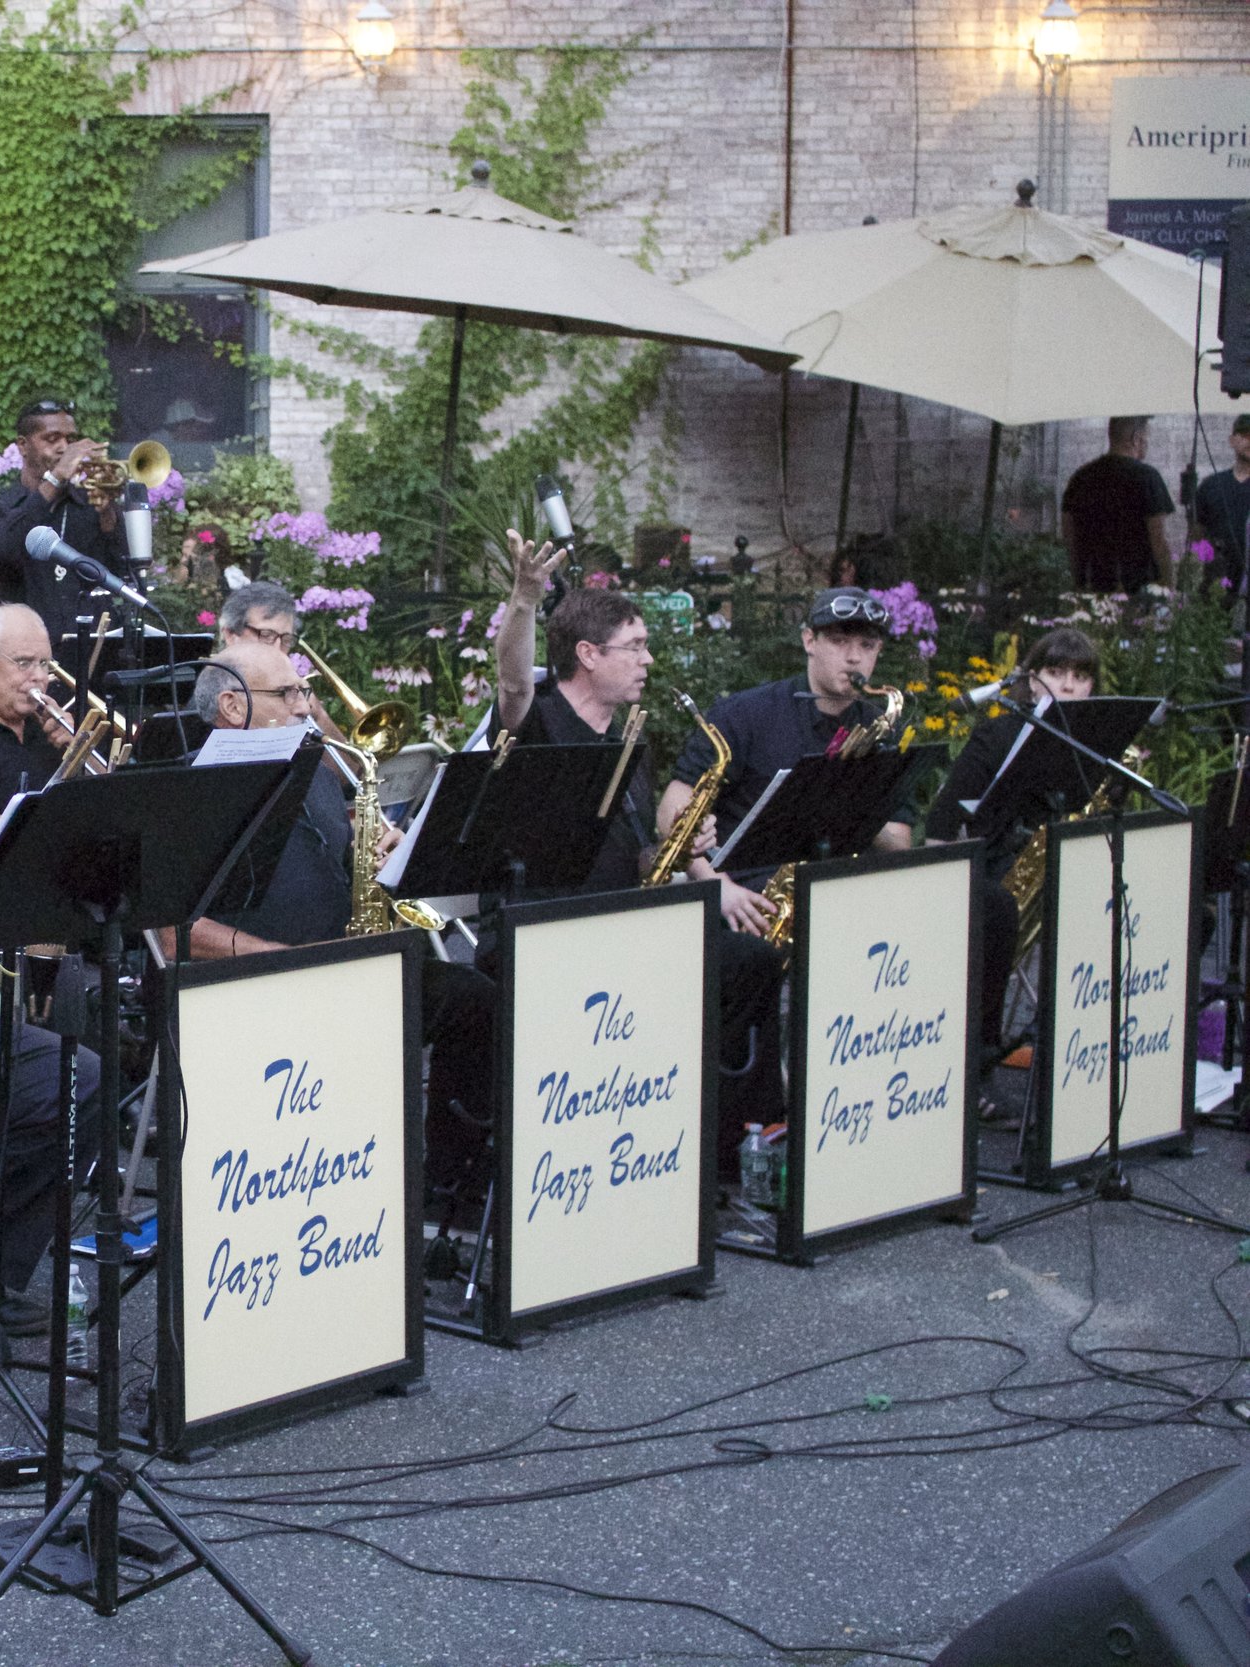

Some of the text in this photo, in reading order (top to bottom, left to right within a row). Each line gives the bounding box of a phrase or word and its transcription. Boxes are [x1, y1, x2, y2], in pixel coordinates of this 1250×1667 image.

[1127, 124, 1250, 154] Ameripri
[1125, 211, 1171, 224] James
[867, 941, 910, 993] The
[1070, 958, 1169, 1009] Norhport
[584, 991, 635, 1046] The
[826, 1008, 946, 1066] Northport
[1062, 1013, 1174, 1090] Jazz Band
[67, 1053, 78, 1181] ULTIMATE
[264, 1058, 323, 1121] The
[537, 1063, 678, 1125] Northport
[817, 1067, 952, 1153] Jazz Band
[211, 1134, 376, 1214] Northport
[528, 1128, 685, 1223] Jazz Band
[203, 1208, 386, 1321] Jazz Band
